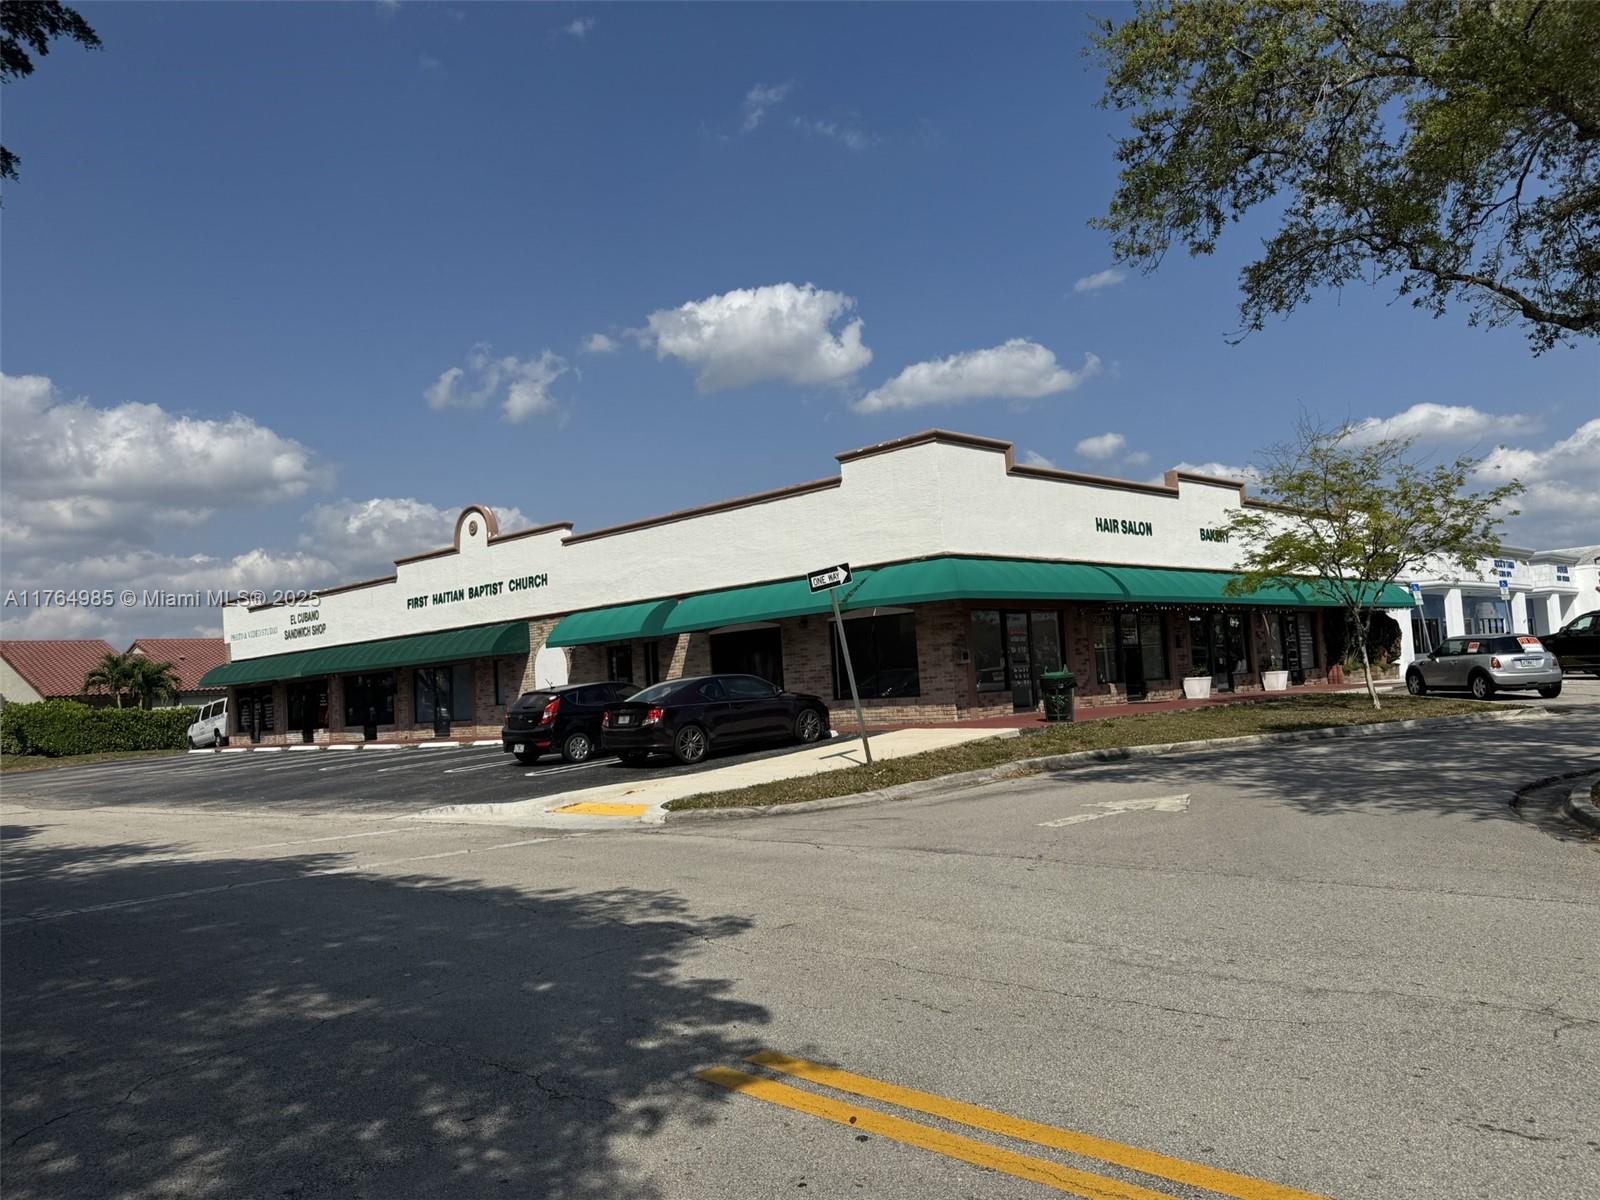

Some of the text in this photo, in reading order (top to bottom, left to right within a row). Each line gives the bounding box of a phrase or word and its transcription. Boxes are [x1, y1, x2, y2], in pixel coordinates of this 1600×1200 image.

[1095, 517, 1152, 536] HAIR SALON
[813, 572, 840, 586] ONE WAY
[407, 573, 548, 609] FIRST HAITIAN BAPTIST CHURCH
[290, 610, 319, 625] EL CUBANO
[284, 623, 326, 640] SANDWICH SHOP
